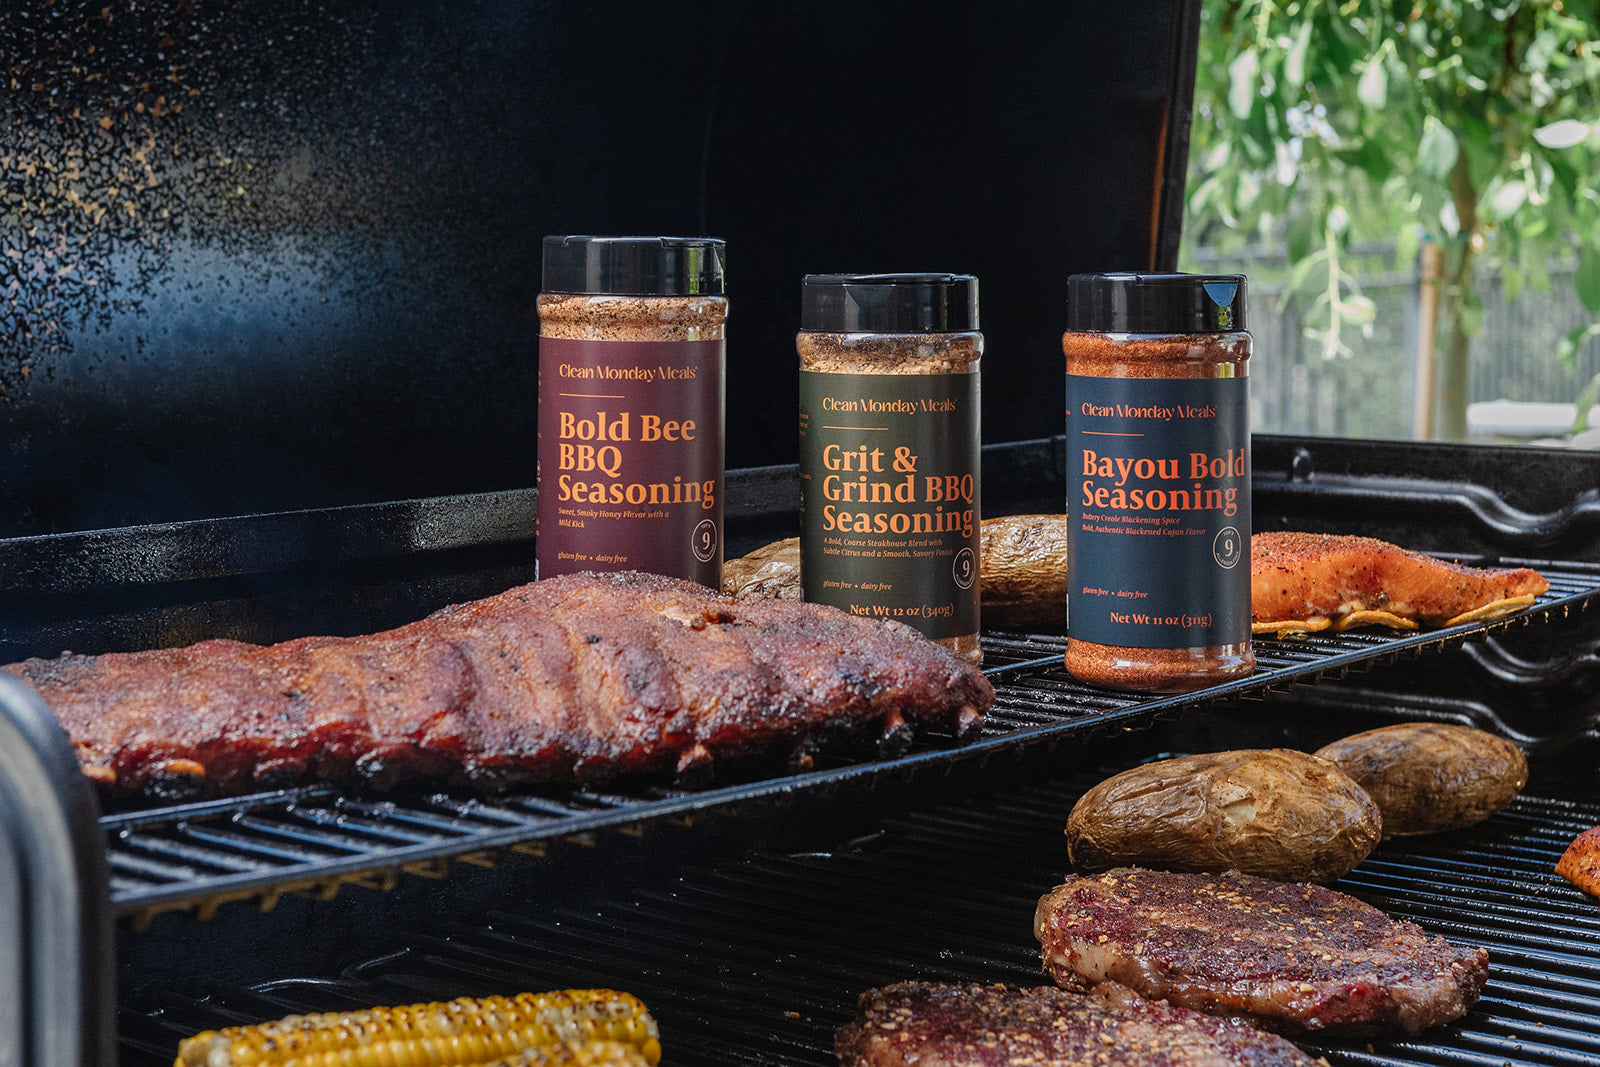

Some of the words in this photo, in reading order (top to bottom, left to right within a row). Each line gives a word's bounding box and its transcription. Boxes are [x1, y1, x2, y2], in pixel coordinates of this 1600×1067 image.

[559, 363, 594, 379] Clean
[597, 365, 656, 382] Monday
[822, 397, 858, 412] Clean
[860, 398, 918, 415] Monday
[1082, 402, 1114, 417] Clean
[1116, 404, 1175, 421] Monday
[559, 411, 631, 442] Bold
[640, 414, 696, 442] Bee
[558, 443, 622, 478] BBQ
[822, 444, 885, 472] Grit
[892, 446, 918, 472] &
[1082, 449, 1180, 486] Bayou
[1189, 448, 1246, 480] Bold
[558, 474, 716, 510] Seasoning
[822, 474, 916, 504] Grind
[924, 474, 974, 505] BBQ
[1082, 480, 1238, 517] Seasoning
[558, 507, 576, 517] Sweet,
[576, 510, 598, 519] Smoky
[599, 510, 622, 520] Honey
[623, 510, 646, 518] Flavor
[648, 510, 664, 518] with
[823, 504, 974, 538] Seasoning
[1100, 514, 1120, 523] Creole
[1122, 516, 1160, 526] Blackening
[1161, 517, 1181, 526] Spice
[558, 518, 571, 527] Mild
[572, 520, 586, 528] Kick
[1082, 524, 1094, 532] Bold,
[1094, 525, 1124, 534] Authentic
[1124, 527, 1162, 536] Blackened
[1162, 528, 1184, 537] Cajun
[702, 532, 710, 550] 9
[828, 538, 842, 546] Bold,
[867, 539, 906, 548] Steakhouse
[908, 539, 928, 547] Blend
[928, 538, 942, 546] with
[1224, 539, 1234, 557] 9
[558, 552, 574, 560] gluten
[574, 552, 587, 562] free
[595, 554, 614, 562] dairy
[613, 554, 628, 563] free
[823, 547, 840, 555] Subtle
[841, 549, 861, 557] Citrus
[882, 550, 912, 558] Smooth,
[912, 550, 934, 559] Savory
[962, 560, 970, 578] 9
[823, 580, 840, 588] gluten
[840, 581, 852, 590] free
[860, 582, 878, 591] dairy
[878, 583, 892, 592] free
[1098, 588, 1109, 597] free
[1117, 589, 1134, 598] dairy
[1134, 590, 1148, 599] free
[850, 604, 870, 616] Net
[872, 605, 890, 616] Wt
[893, 608, 904, 616] 12
[906, 608, 920, 616] oz
[921, 604, 954, 618] (340g)
[1110, 612, 1130, 624] Net
[1132, 614, 1150, 625] Wt
[1152, 616, 1163, 625] 11
[1165, 616, 1180, 625] oz
[1181, 613, 1212, 628] (311g)
